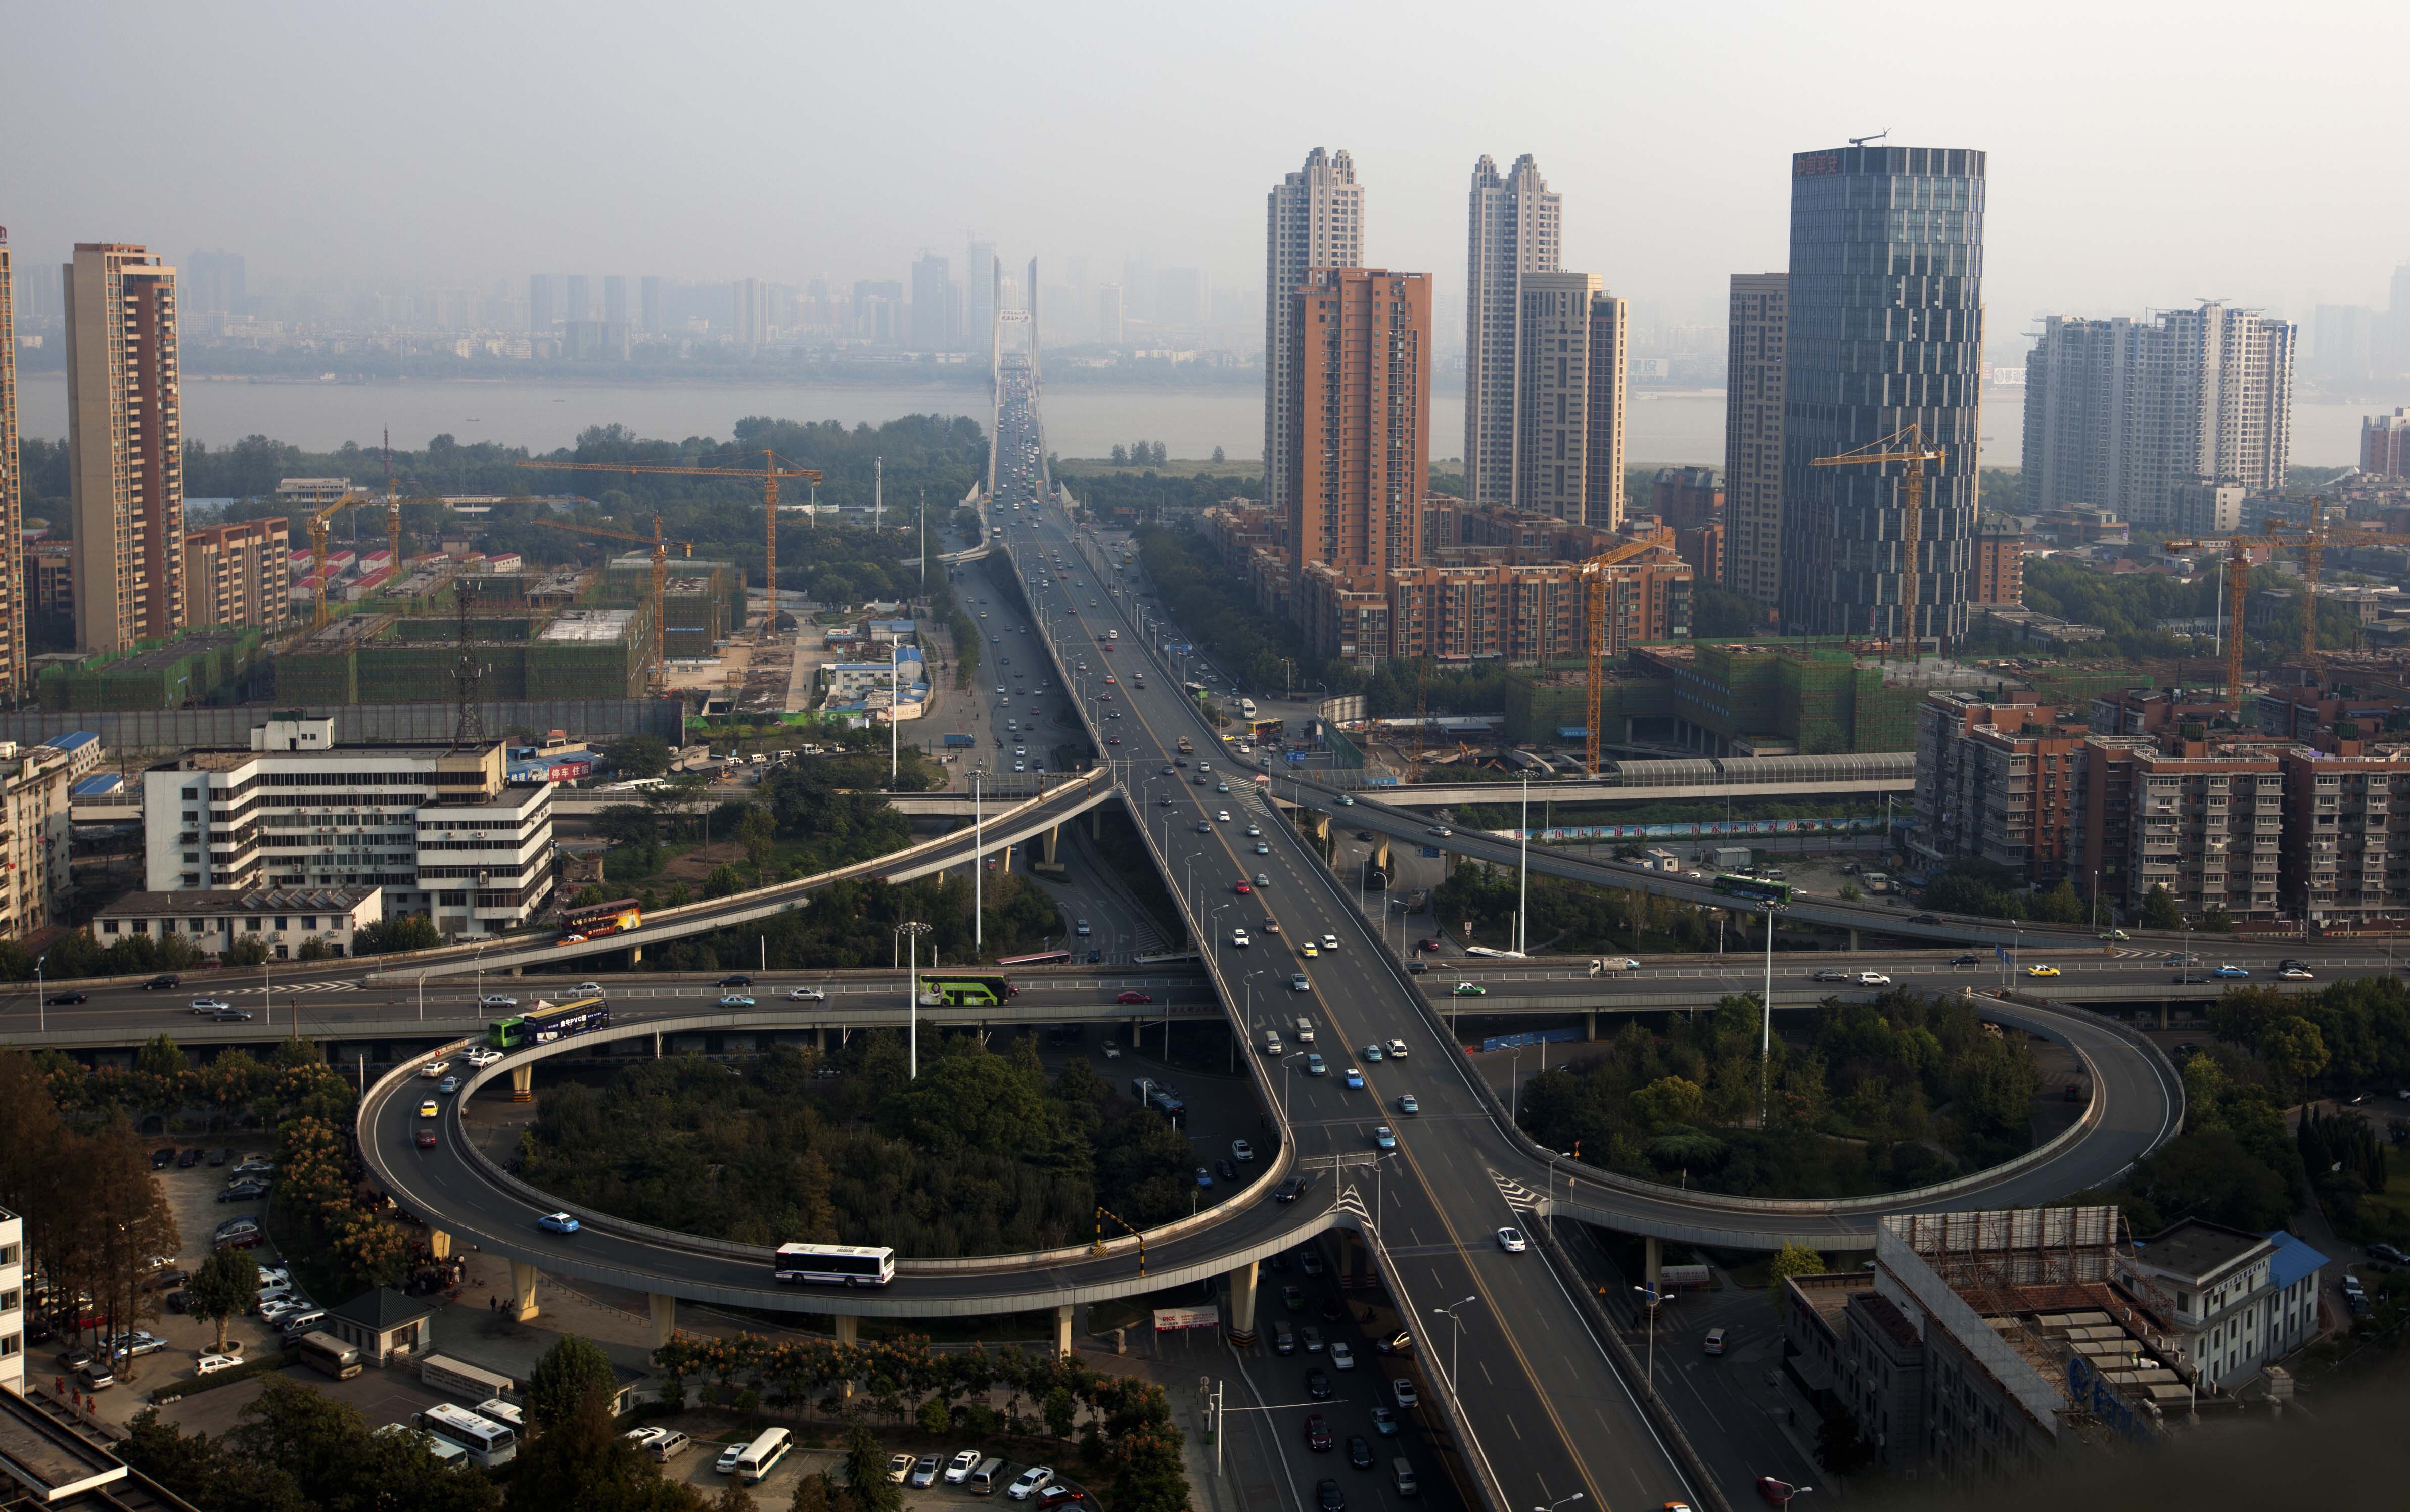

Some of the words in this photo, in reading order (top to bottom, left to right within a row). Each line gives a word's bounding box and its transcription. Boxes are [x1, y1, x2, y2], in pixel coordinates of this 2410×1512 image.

[1795, 155, 1838, 175] 中国平安
[507, 773, 526, 782] 修理
[551, 767, 569, 779] 停车
[572, 764, 589, 776] 住宿
[560, 1014, 587, 1027] 金牛PVC管
